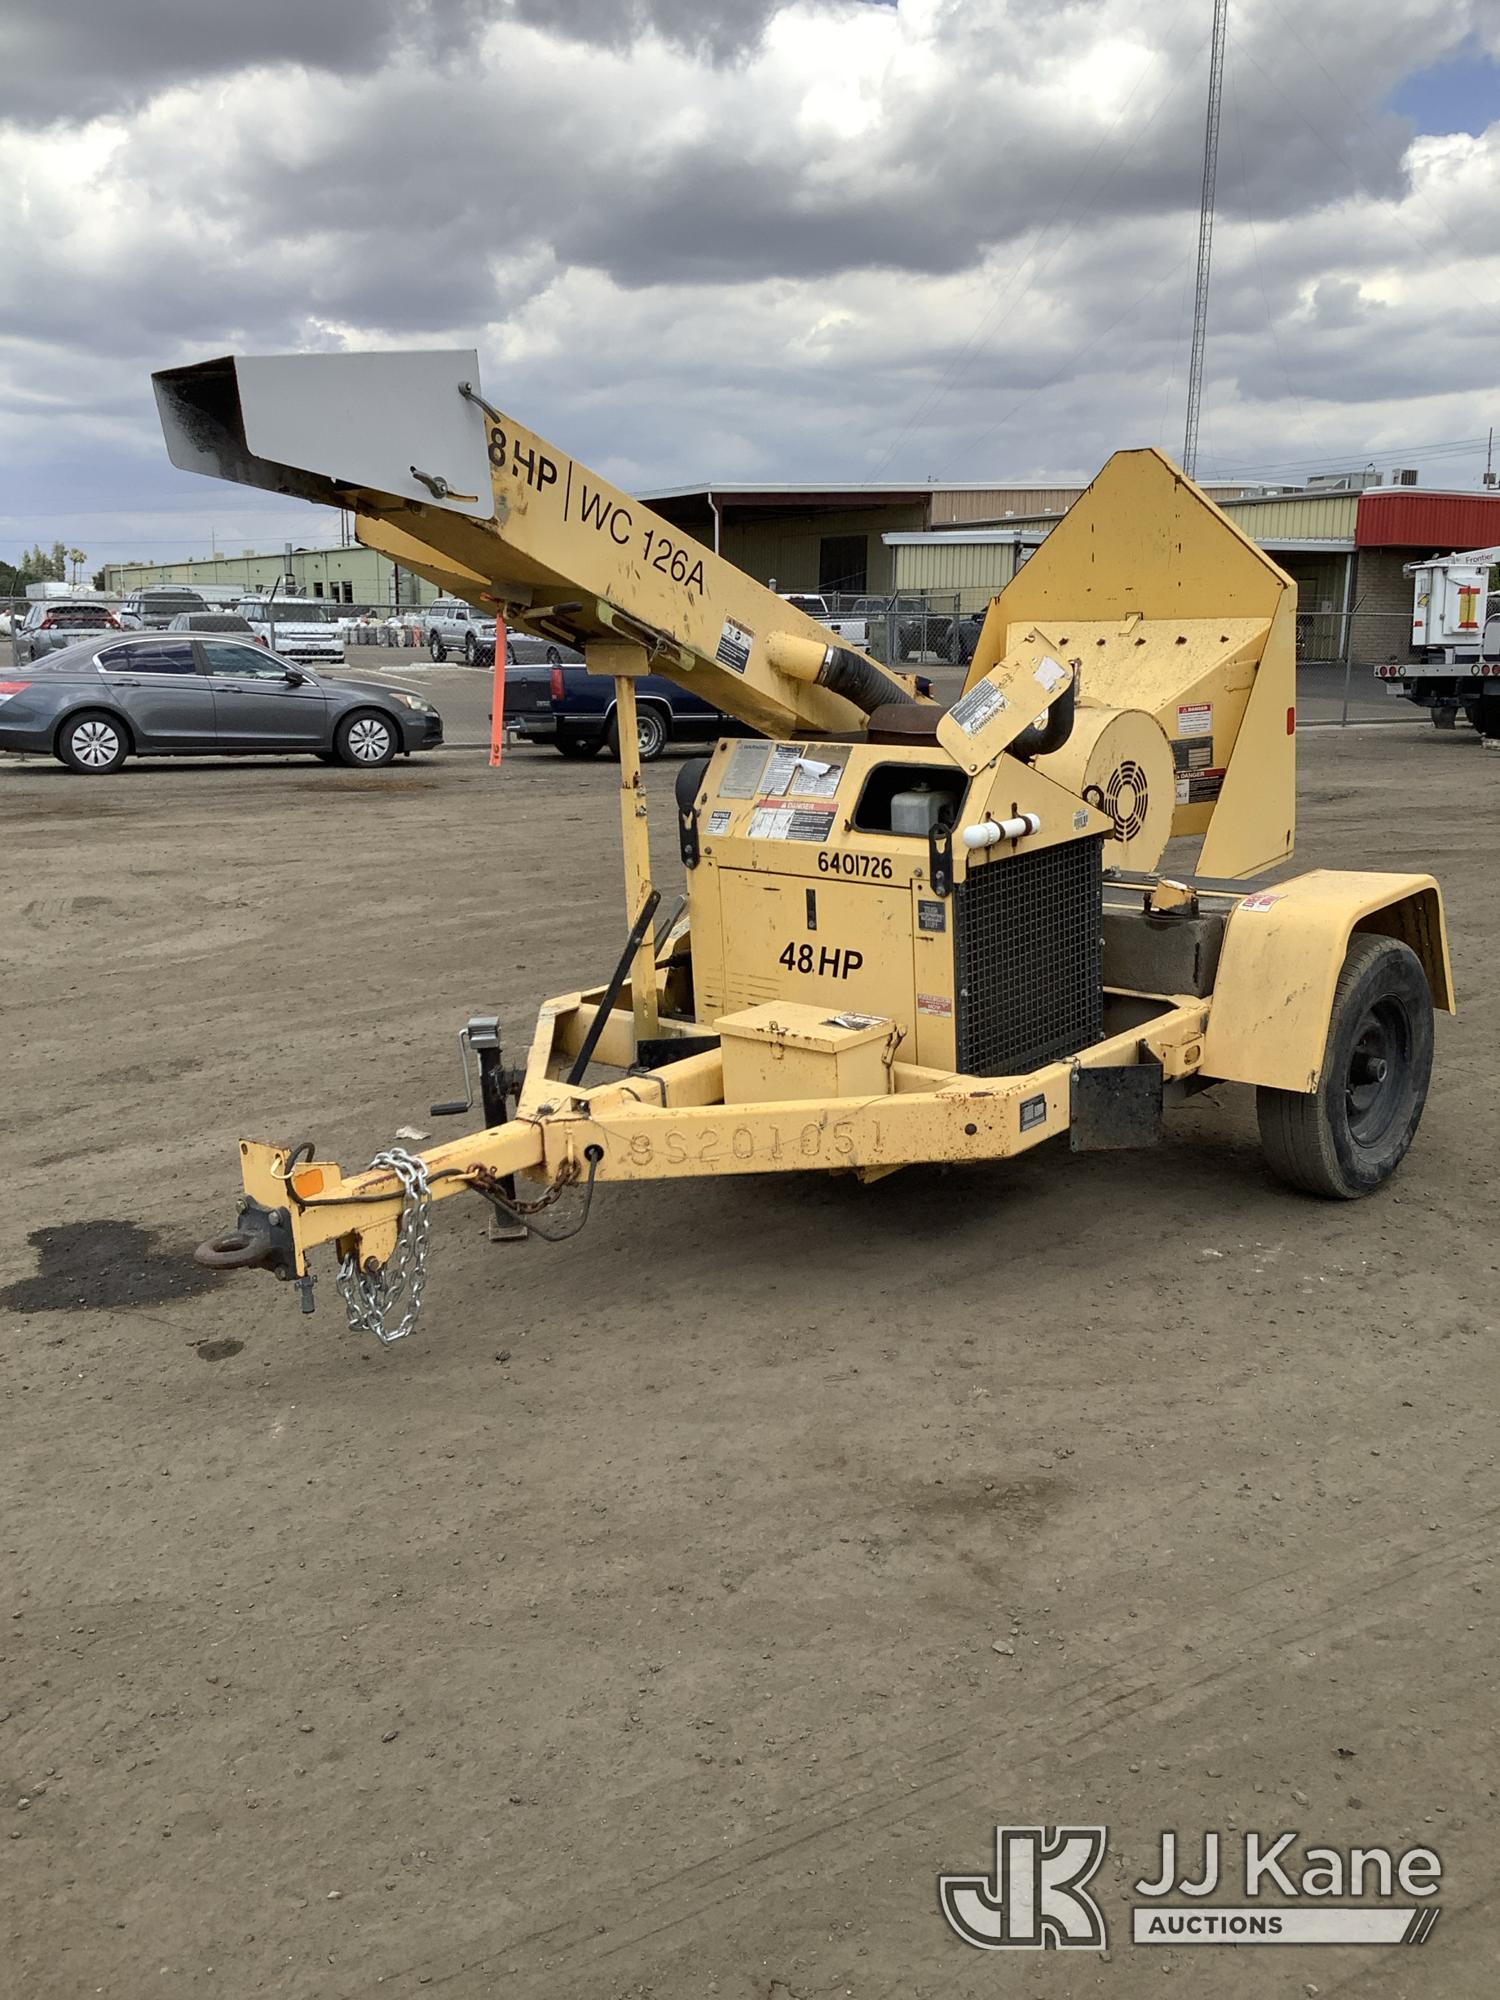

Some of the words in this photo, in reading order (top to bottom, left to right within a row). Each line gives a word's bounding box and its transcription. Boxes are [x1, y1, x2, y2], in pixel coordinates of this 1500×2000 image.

[581, 485, 633, 544] WC
[644, 530, 704, 596] 126A
[1465, 553, 1493, 563] Frontier
[1180, 771, 1205, 779] DANGER
[818, 851, 893, 879] 6401726
